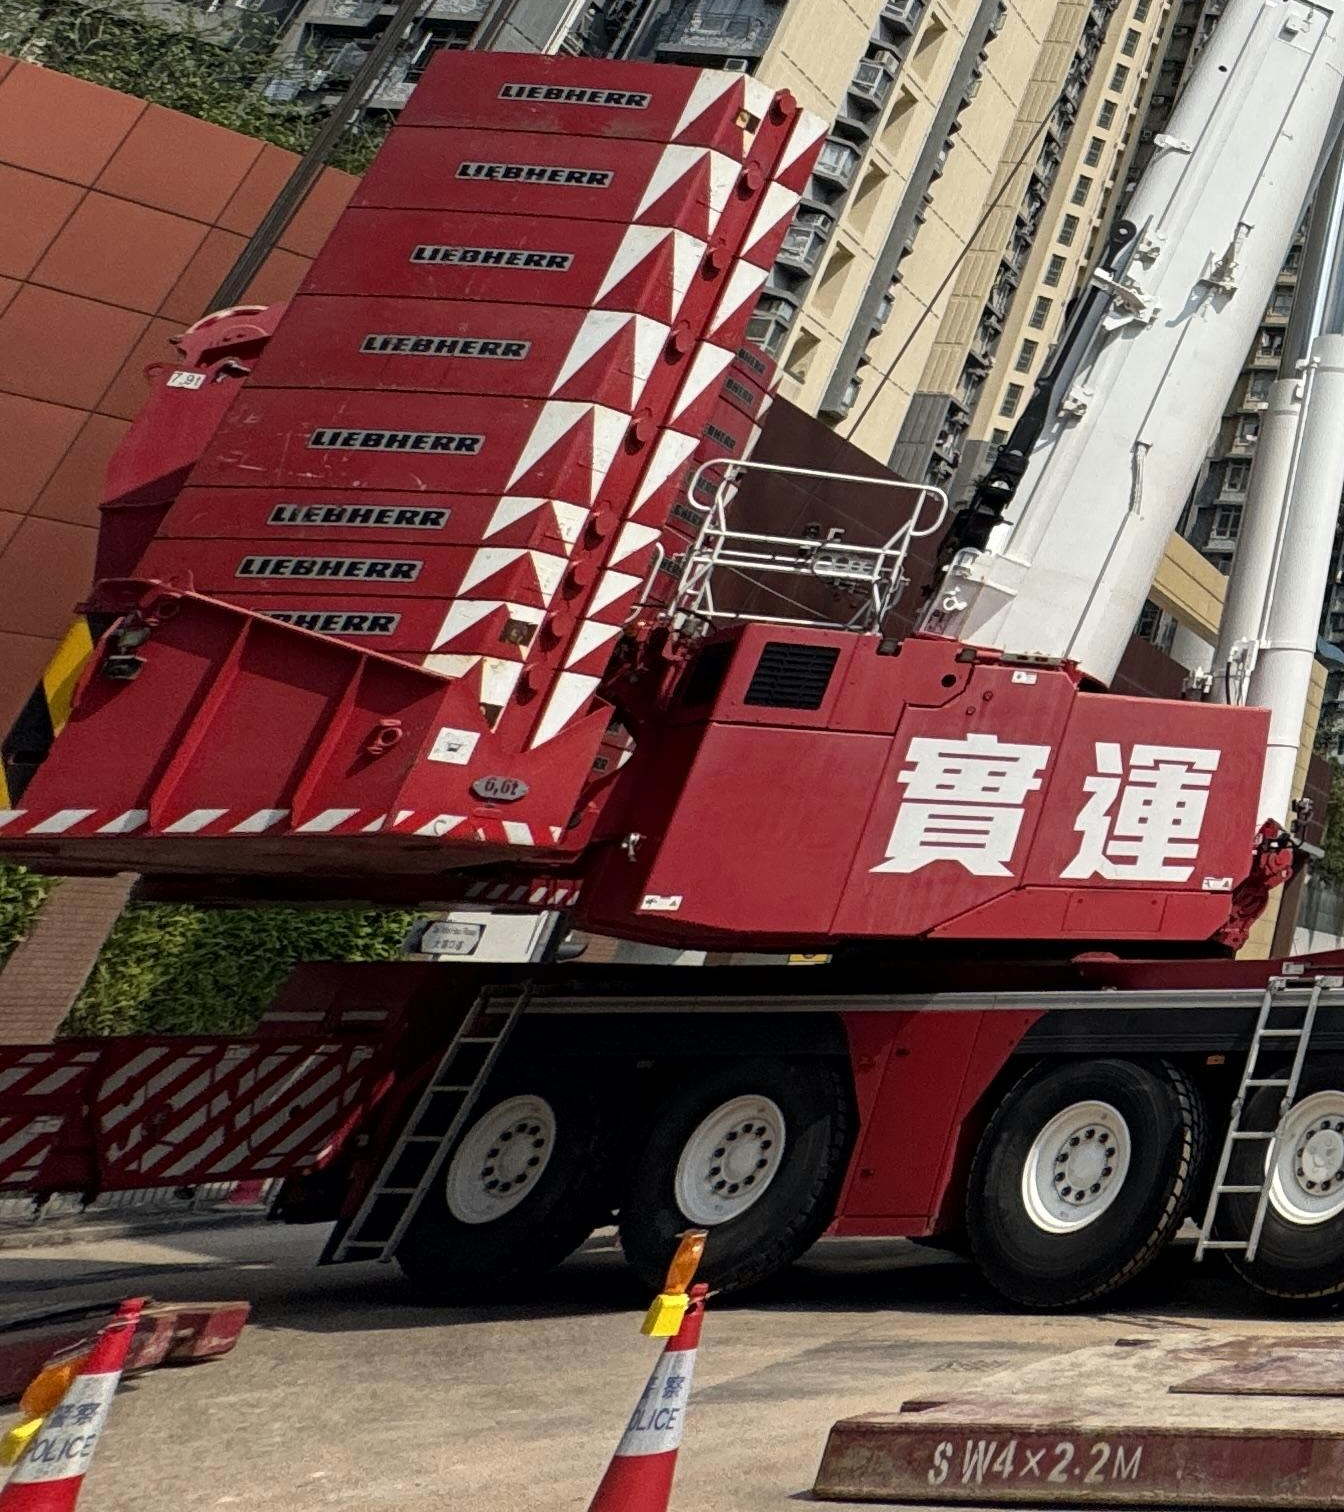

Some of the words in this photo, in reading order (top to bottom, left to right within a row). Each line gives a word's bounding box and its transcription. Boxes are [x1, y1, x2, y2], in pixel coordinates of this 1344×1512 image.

[500, 85, 648, 108] LIEBHERR
[457, 163, 610, 187] LIEBHERR
[413, 246, 570, 269] LIEBHERR
[364, 336, 528, 359] LIEBHERR
[309, 430, 483, 453] LIEBHERR
[271, 505, 447, 528] LIEBHERR
[238, 558, 421, 580] LIEBHERR
[868, 733, 1221, 882] 實運
